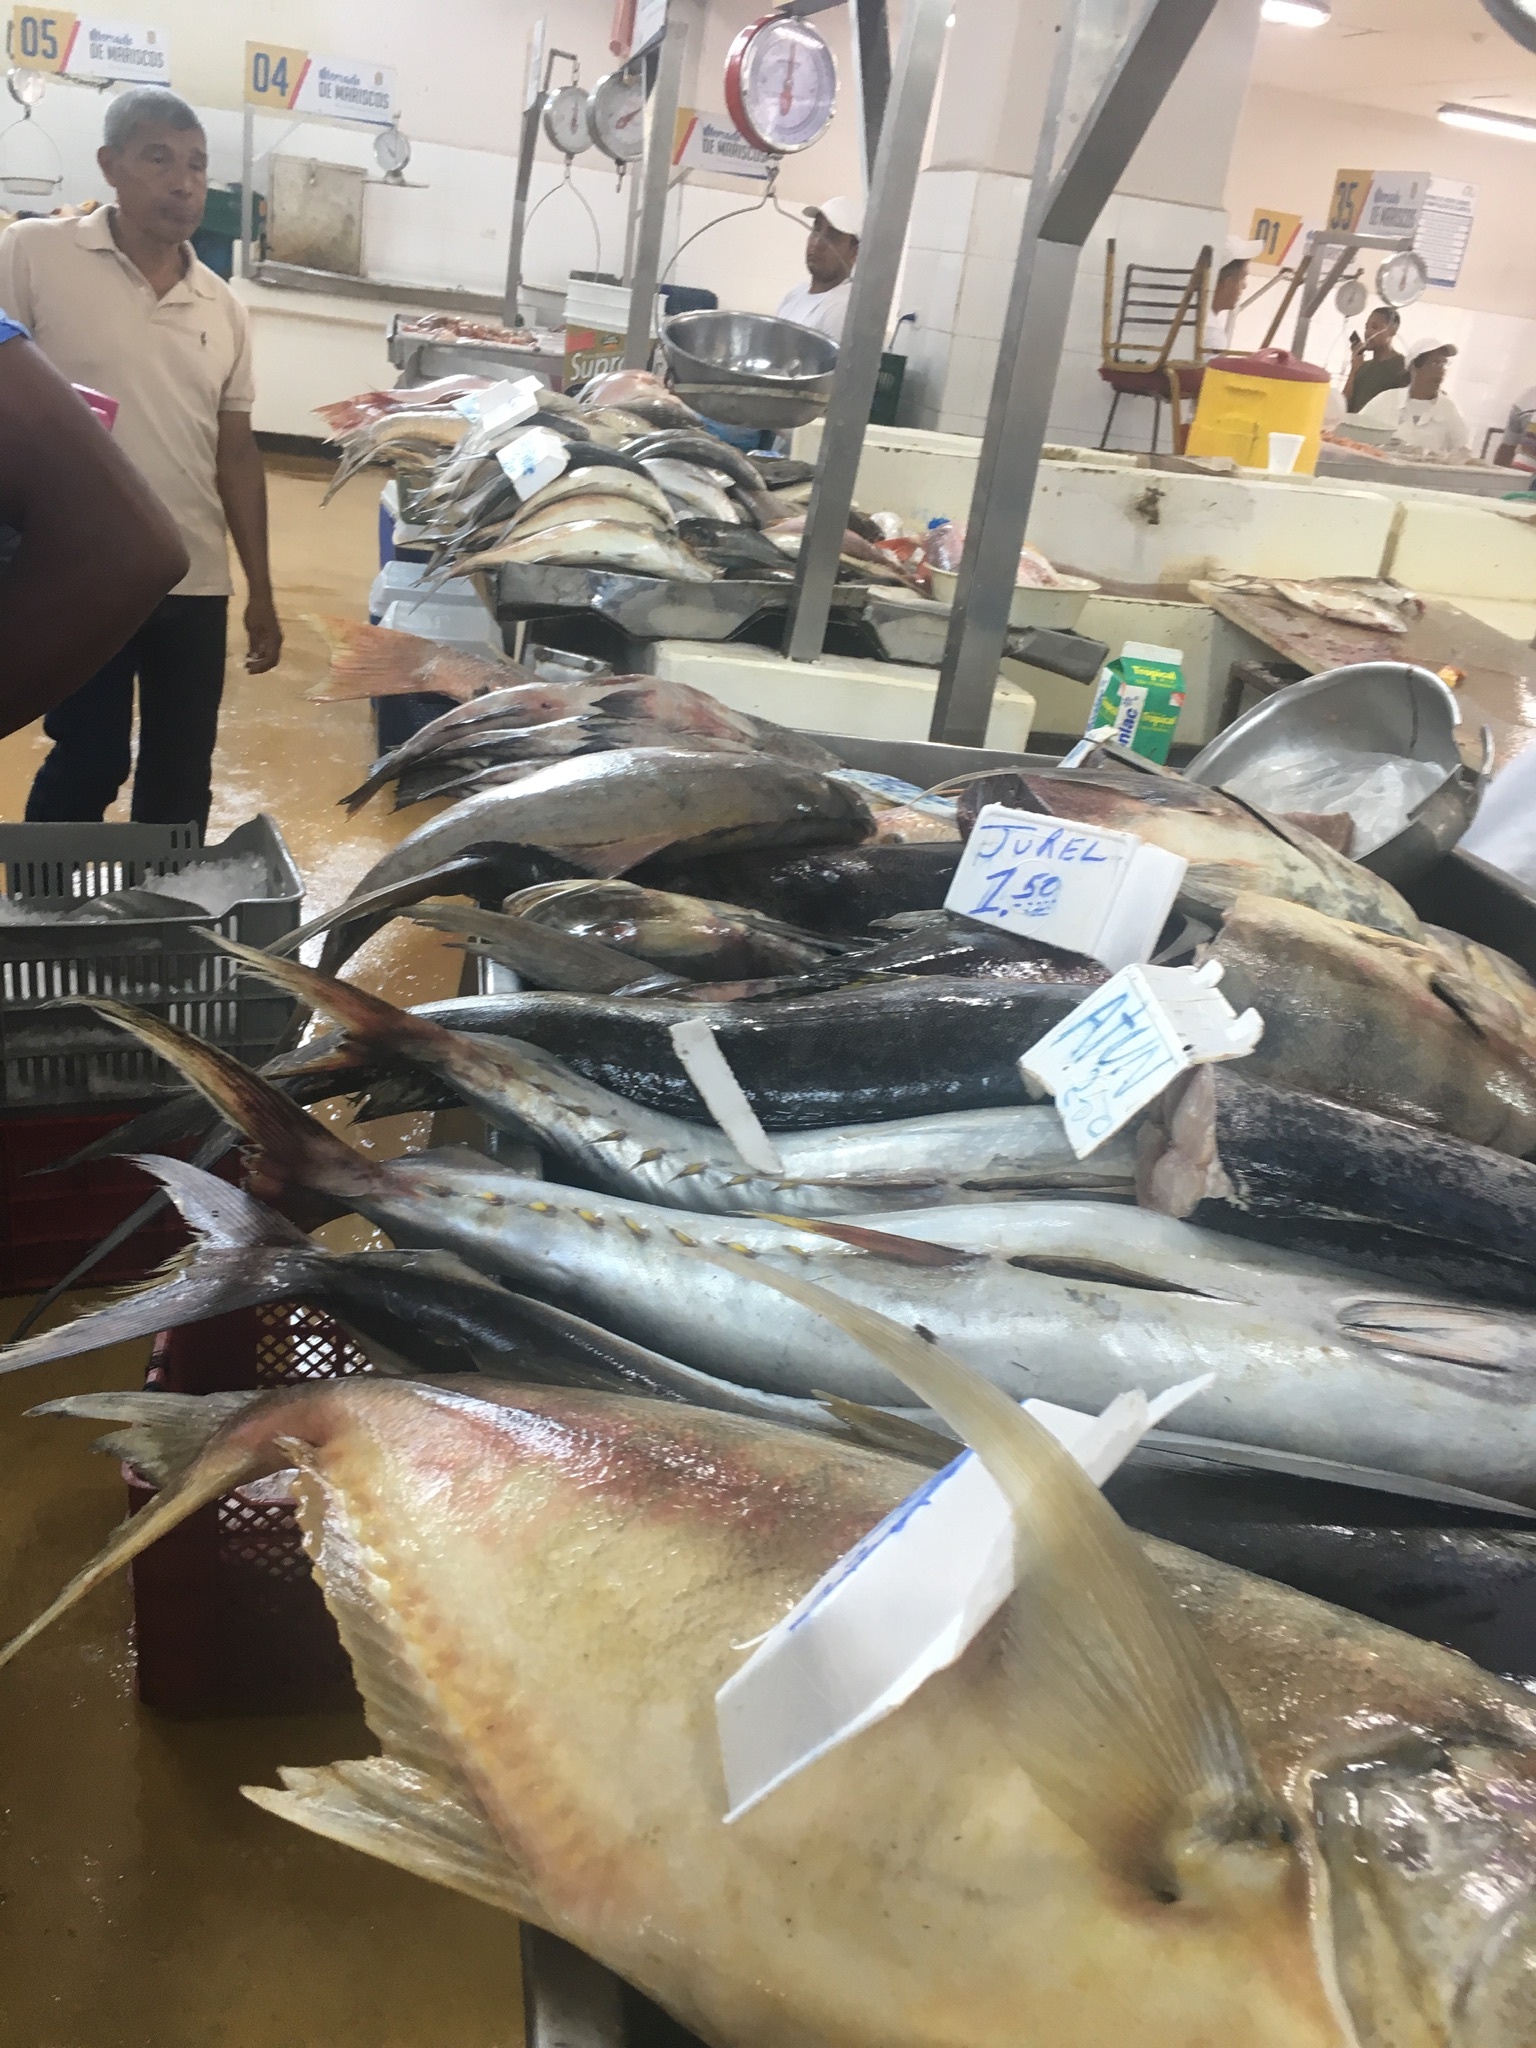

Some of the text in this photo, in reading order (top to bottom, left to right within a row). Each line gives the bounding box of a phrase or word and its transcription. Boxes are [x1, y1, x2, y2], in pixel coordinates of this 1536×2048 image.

[21, 16, 58, 60] 05
[89, 43, 165, 69] DE MARISCOS
[253, 52, 289, 97] 04
[318, 81, 390, 110] DE MARISCOS
[979, 825, 1107, 863] JUREL
[968, 866, 1062, 917] 1.50
[1049, 992, 1174, 1099] ATUN
